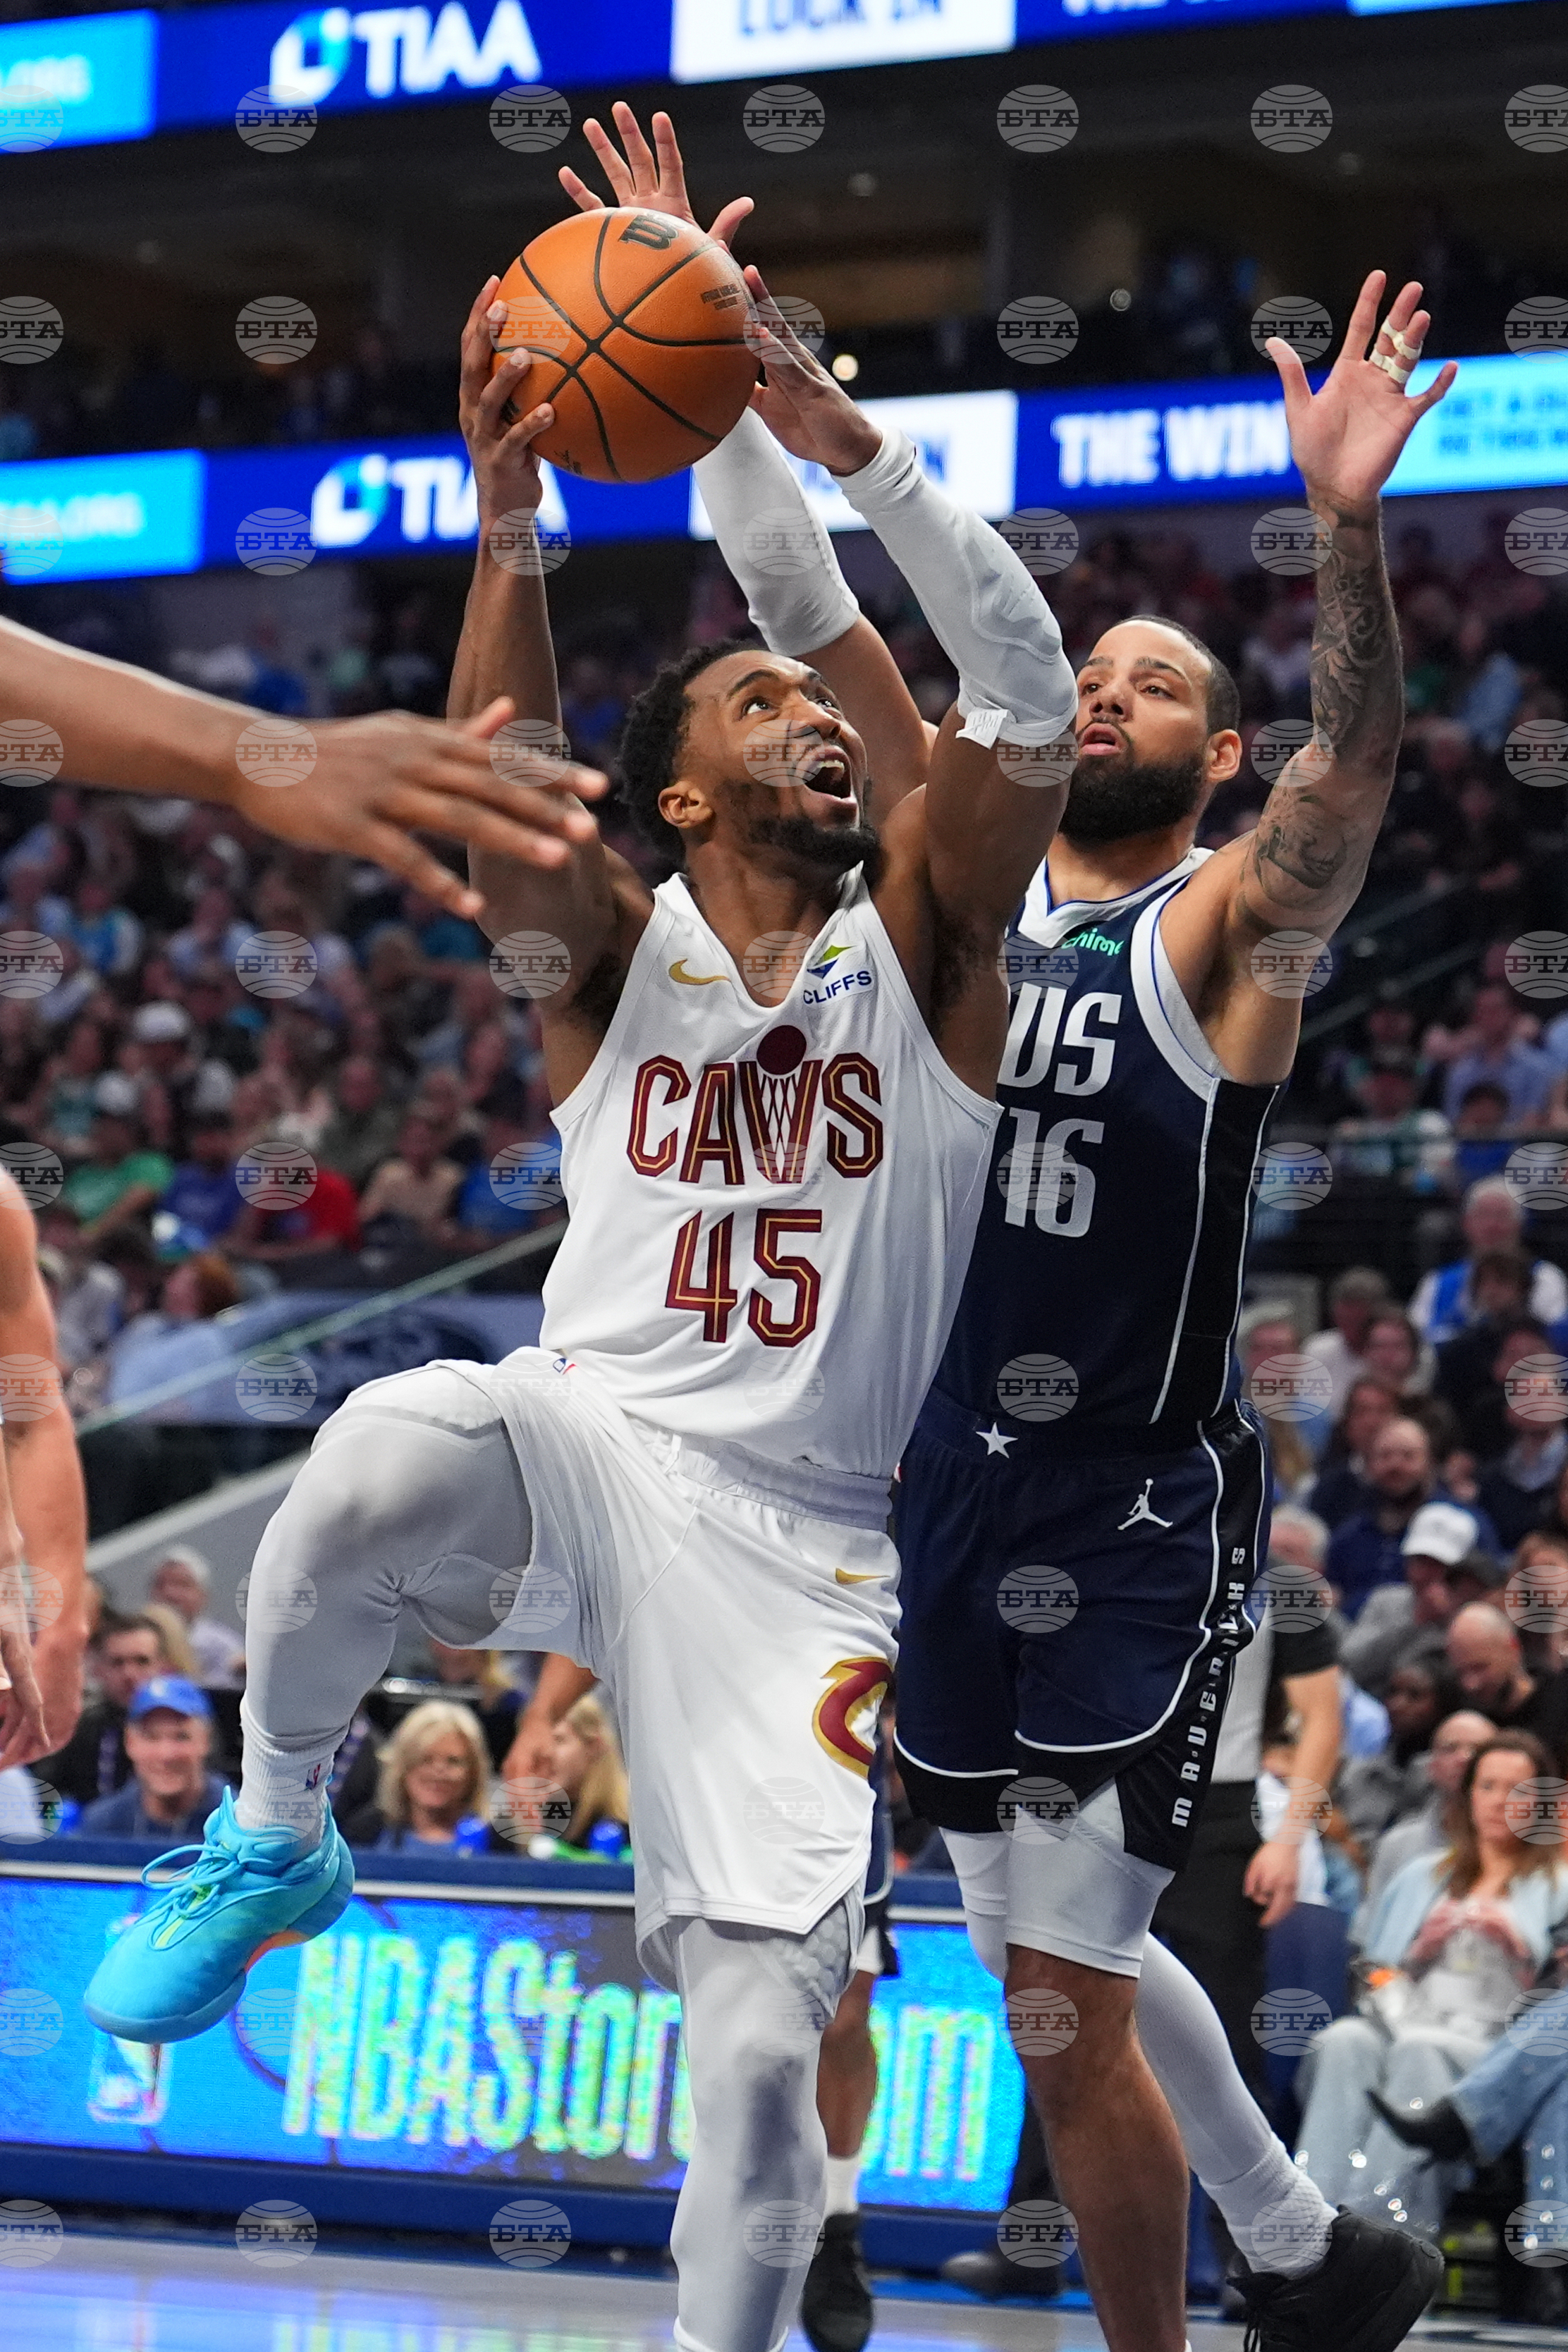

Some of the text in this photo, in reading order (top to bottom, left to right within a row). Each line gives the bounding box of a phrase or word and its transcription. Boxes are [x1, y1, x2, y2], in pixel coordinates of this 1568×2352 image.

[353, 0, 543, 99] TIAA
[1051, 399, 1292, 488] THE WIN
[803, 970, 872, 1005] CLIFFS
[626, 1053, 883, 1185] CAVS
[1004, 1107, 1105, 1238] 16
[665, 1208, 822, 1348] 45
